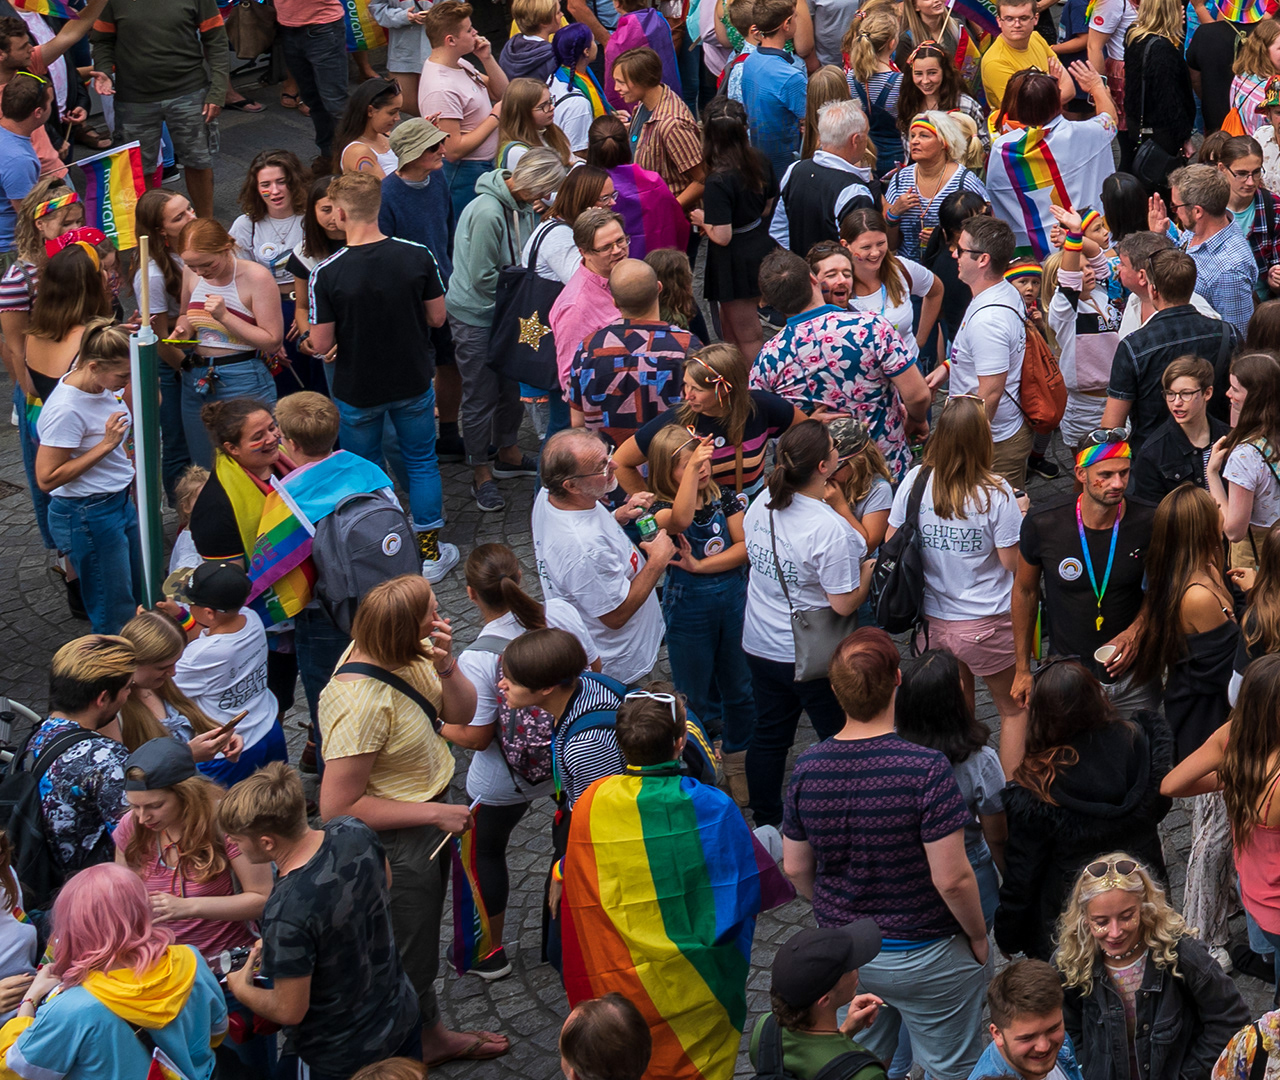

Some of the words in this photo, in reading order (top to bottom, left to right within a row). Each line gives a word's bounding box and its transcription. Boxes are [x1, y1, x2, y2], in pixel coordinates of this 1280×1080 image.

[103, 168, 120, 238] mourant
[920, 523, 983, 540] CHIEVE
[921, 536, 983, 552] REATER
